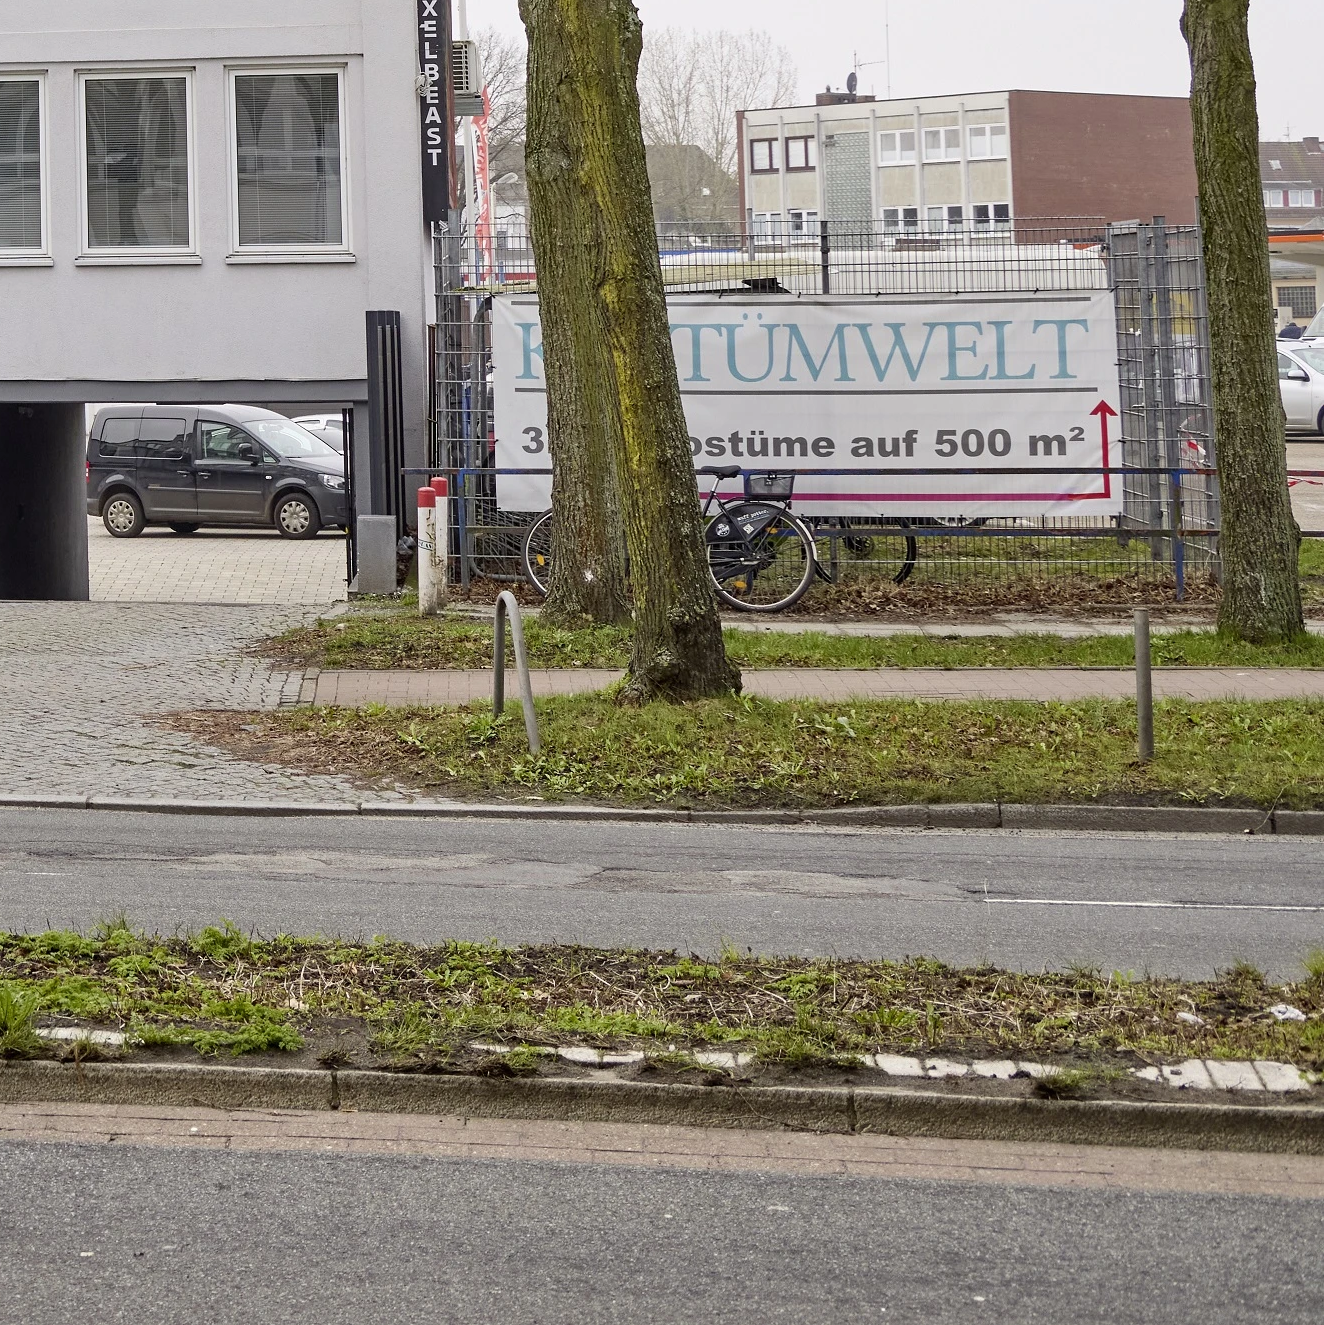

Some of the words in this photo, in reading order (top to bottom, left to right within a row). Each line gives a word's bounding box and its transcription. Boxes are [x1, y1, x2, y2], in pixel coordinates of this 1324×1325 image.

[514, 312, 1090, 383] KTÜMWELT
[688, 430, 836, 458] ostüme
[850, 430, 919, 458] auf
[934, 428, 1013, 458] 500
[1028, 426, 1085, 457] m²
